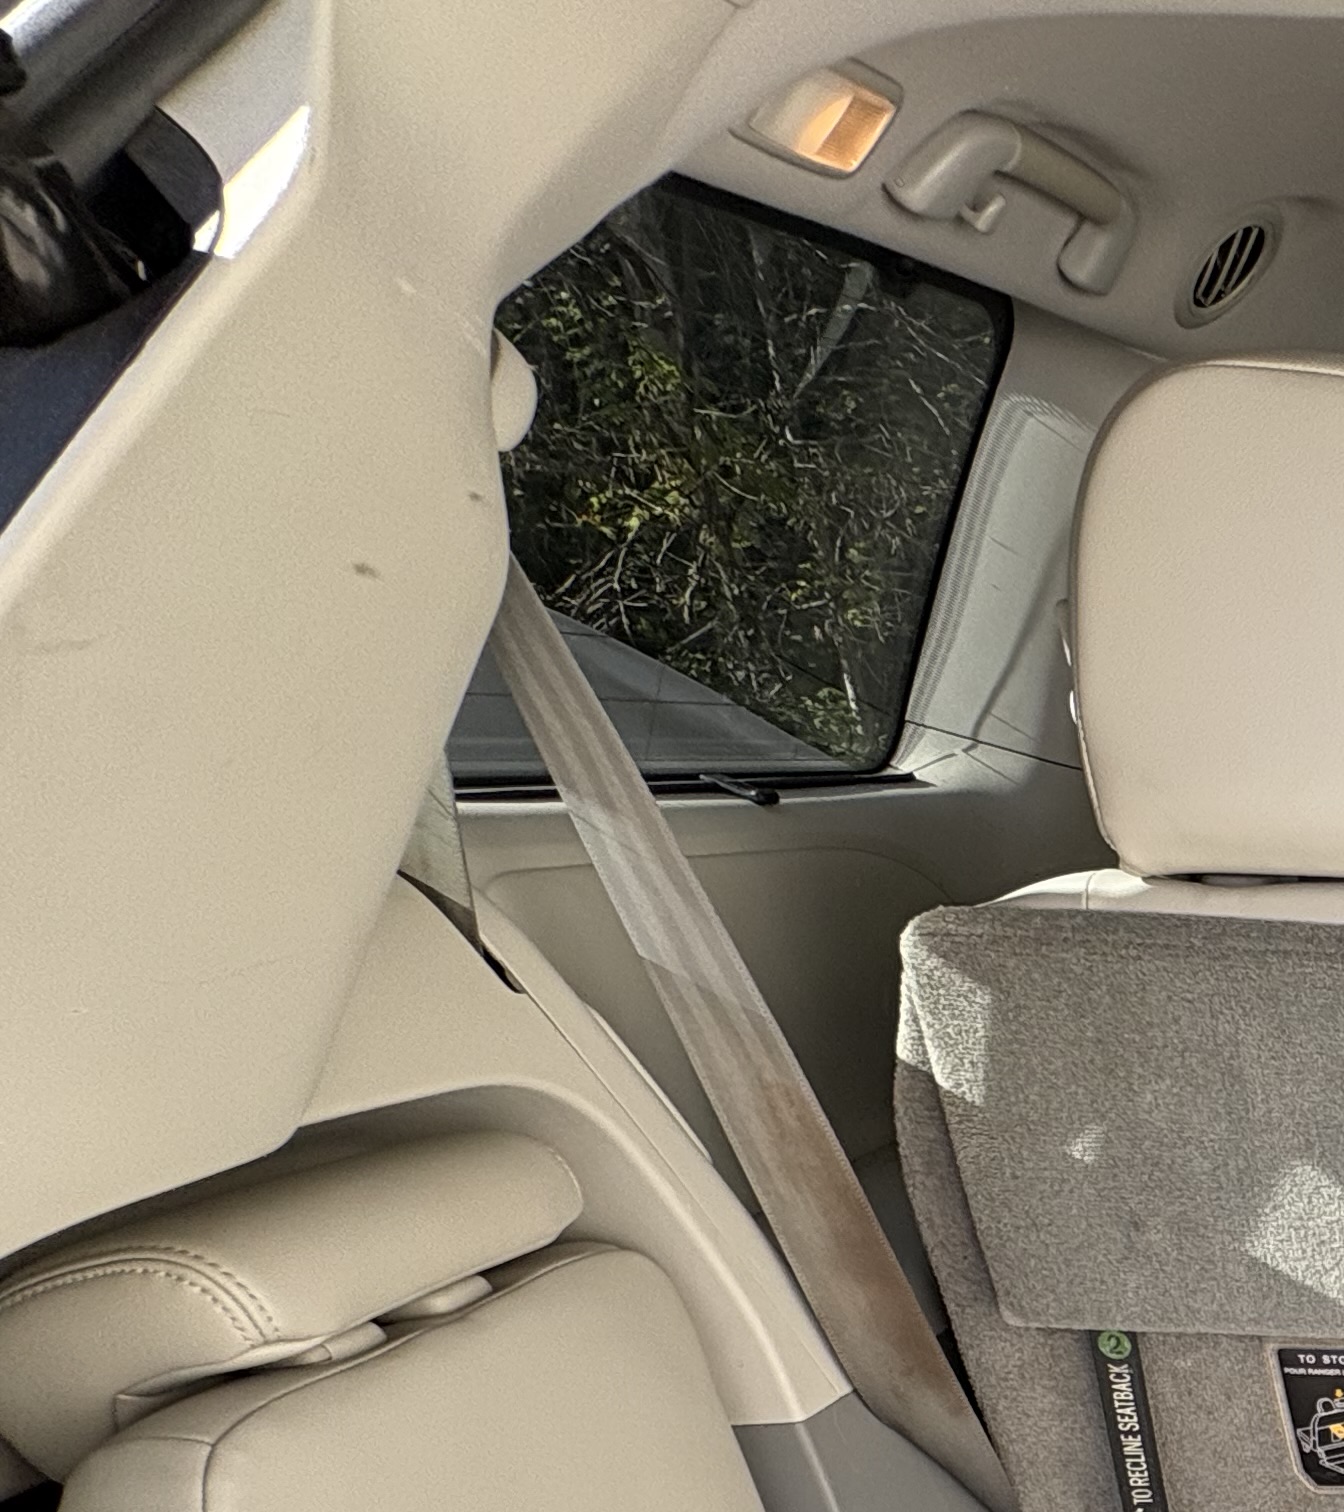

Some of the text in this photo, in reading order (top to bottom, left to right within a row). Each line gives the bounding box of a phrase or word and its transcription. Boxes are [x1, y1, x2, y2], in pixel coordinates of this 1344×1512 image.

[1297, 1354, 1316, 1364] TO
[1283, 1366, 1307, 1375] POUR
[1107, 1363, 1153, 1505] TO RECLINE SEATBACK
